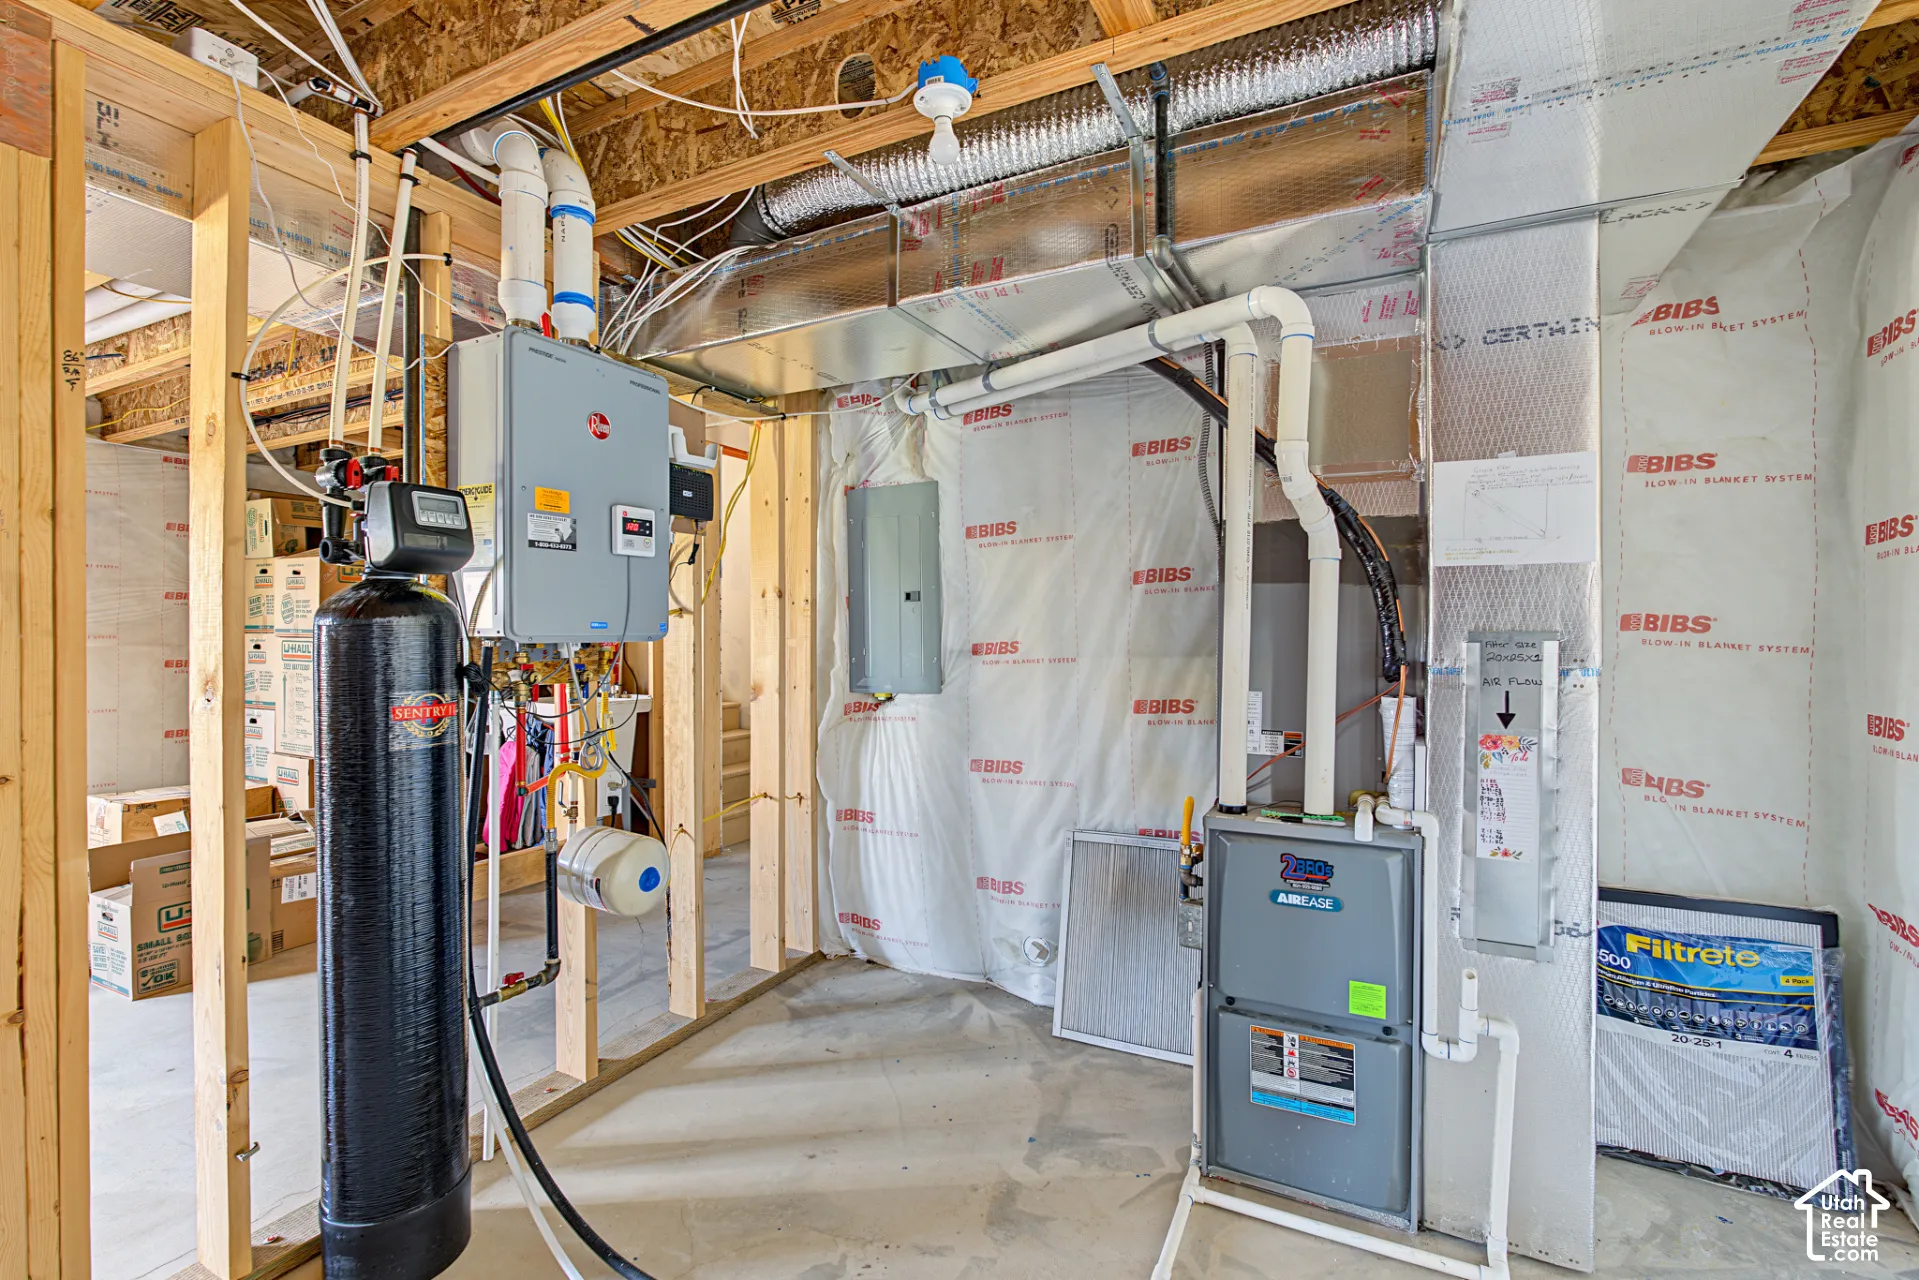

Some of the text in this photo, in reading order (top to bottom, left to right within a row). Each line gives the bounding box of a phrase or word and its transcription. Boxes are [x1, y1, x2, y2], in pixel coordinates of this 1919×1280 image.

[1651, 296, 1720, 322] BIBS
[1650, 322, 1704, 336] BLOW-IN
[1752, 309, 1804, 328] SYSTEM
[1881, 309, 1917, 347] BIBS
[974, 403, 1013, 423] BIBS
[1005, 416, 1037, 427] BLANKET
[1040, 411, 1068, 421] SYSTEM
[1146, 435, 1193, 455] BIBS
[1146, 456, 1179, 467] BLOW-IN
[1647, 453, 1716, 474] BIBS
[1704, 475, 1758, 485] BLANKET
[1764, 473, 1812, 483] SYSTEM
[978, 521, 1017, 538] BIBS
[1877, 514, 1915, 544] BIBS
[1046, 534, 1074, 542] SYSTEM
[1145, 566, 1193, 584] BIBS
[1144, 585, 1216, 595] BLOW-IN BLANKE
[1642, 613, 1712, 635] BIBS
[284, 643, 312, 653] U-HAUL
[984, 640, 1020, 656] BIBS
[1485, 640, 1510, 650] Filter
[1641, 638, 1810, 654] BLOW-IN BLANKET SYSTEM
[1482, 676, 1543, 687] AIR FLOW
[395, 705, 447, 720] SENTRY
[1148, 698, 1196, 715] BIBS
[1873, 715, 1905, 742] BIBS
[1895, 750, 1919, 764] BLAN
[984, 759, 1023, 775] BIBS
[843, 808, 874, 824] BIBS
[1692, 806, 1749, 819] BLANKET
[1753, 811, 1806, 829] SYSTEM
[990, 877, 1024, 896] BIBS
[1277, 892, 1334, 910] AIREASE
[850, 913, 881, 931] BIBS
[136, 937, 173, 952] SMALL
[1626, 933, 1761, 969] Filtrete
[1598, 949, 1632, 970] 500
[1616, 975, 1645, 987] Allergen
[1652, 982, 1684, 994] Ultrafine
[1684, 989, 1716, 999] Particles
[1783, 1050, 1794, 1059] 4
